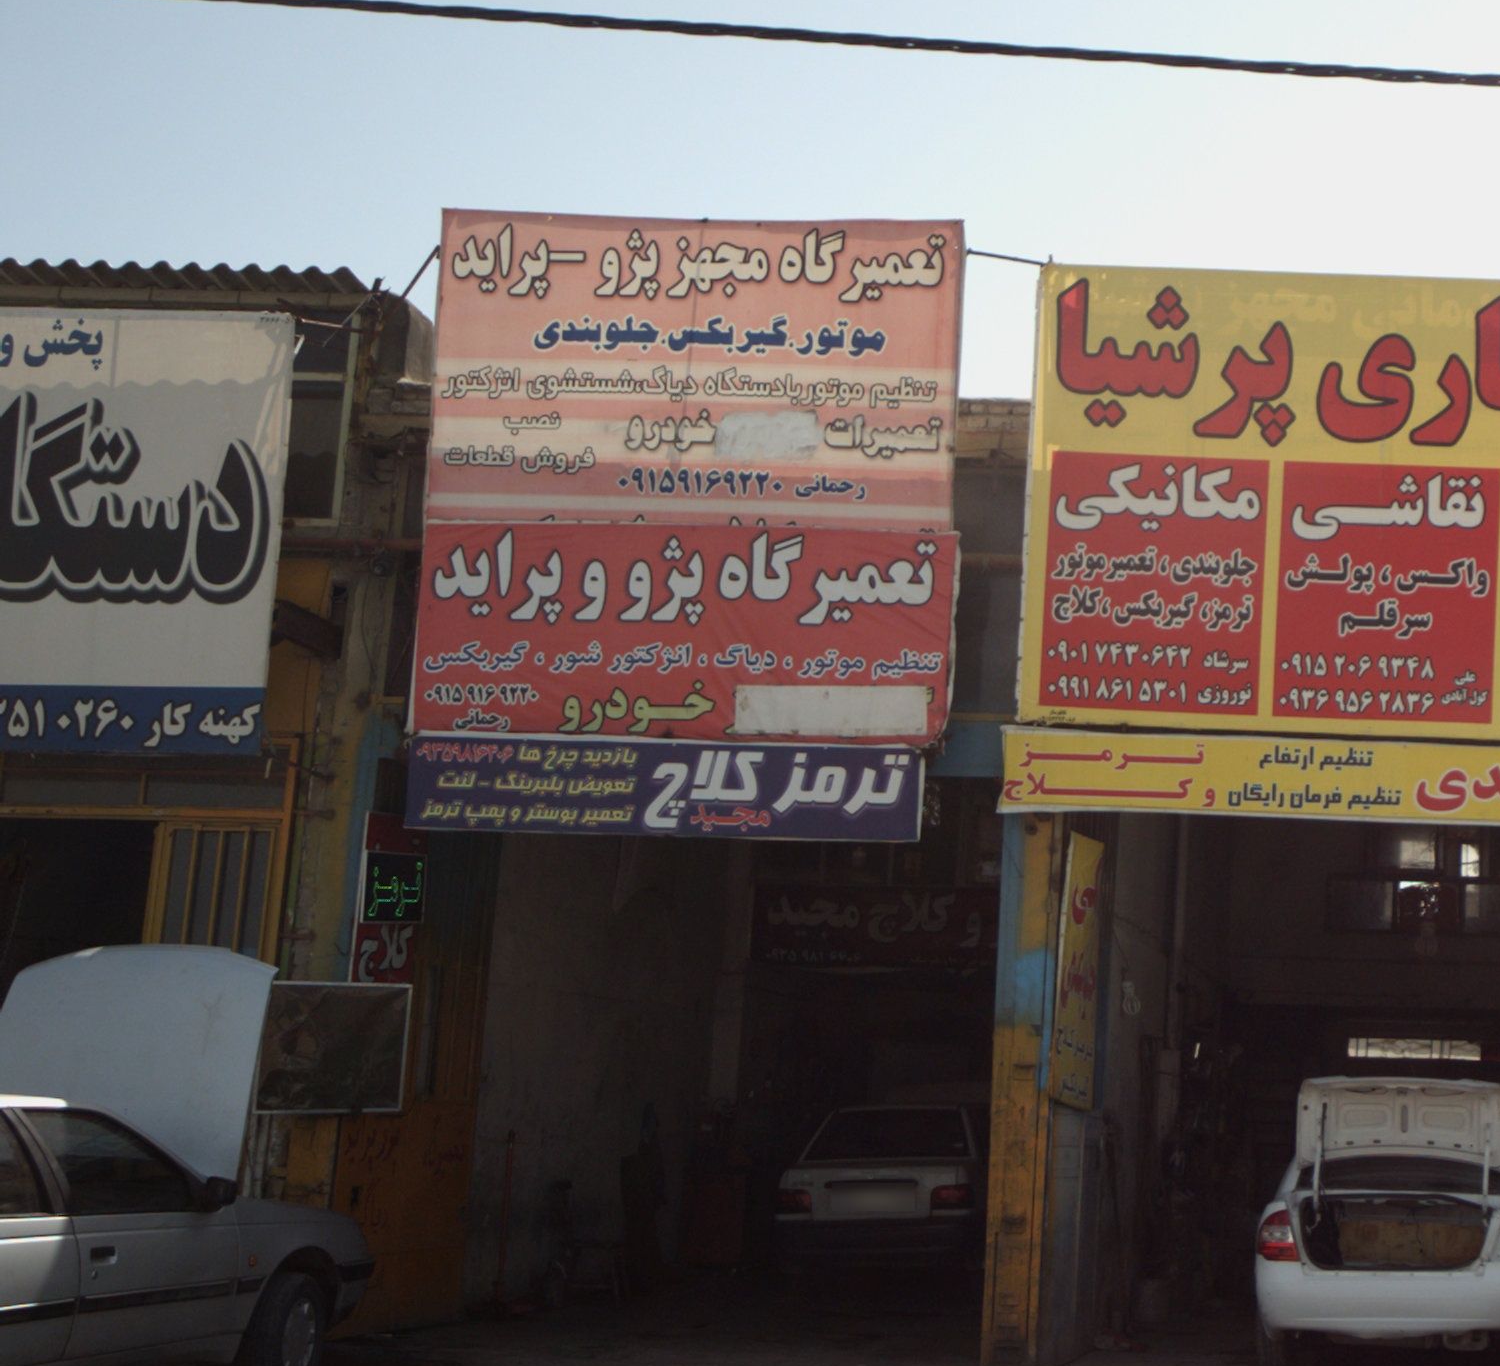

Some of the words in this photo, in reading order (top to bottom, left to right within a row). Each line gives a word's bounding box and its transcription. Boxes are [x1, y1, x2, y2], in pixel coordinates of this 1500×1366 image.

[452, 223, 550, 299] پراید
[594, 228, 661, 300] پژو
[665, 235, 770, 299] مجهز
[23, 318, 104, 370] پخش
[1056, 277, 1296, 447] پرشیا
[440, 366, 520, 399] انژکتور
[527, 368, 635, 399] شستشوی
[869, 375, 939, 409] تنظیم
[502, 411, 562, 435] نصب
[625, 409, 716, 453] خودرو
[824, 414, 943, 459] تعمیرات
[443, 443, 516, 466] قطعات
[521, 445, 596, 474] فروش
[617, 466, 783, 496] ۰۹۱۵۹۱۶۹۲۲۰
[795, 475, 867, 501] رحمانی
[1055, 463, 1262, 532] مکانیکی
[1291, 472, 1485, 541] نقاشی
[433, 528, 564, 624] پراید
[619, 535, 705, 626] پژو
[1171, 548, 1257, 585] جلوبندی
[1285, 553, 1374, 595] پولش
[1396, 556, 1490, 598] واکس
[573, 558, 608, 622] و
[424, 641, 530, 672] گیربکس
[549, 642, 603, 673] شور
[607, 641, 692, 675] انژکتور
[715, 644, 776, 673] دیاگ
[798, 648, 864, 678] موتور
[872, 648, 945, 680] تنظیم
[1047, 639, 1089, 664] ۰۹۰۱
[1280, 651, 1328, 677] ۰۹۱۵
[1333, 654, 1373, 679] ۲۰۶
[1378, 654, 1436, 681] ۹۳۴۸
[425, 682, 463, 706] ۰۹۱۵
[466, 683, 497, 705] ۹۱۶
[500, 682, 540, 705] ۹۲۲۰
[1047, 675, 1090, 699] ۰۹۹۱
[1095, 677, 1133, 701] ۸۶۱
[1138, 677, 1188, 703] ۵۳۰۱
[1197, 682, 1252, 706] نوروزی
[1279, 687, 1330, 711] ۰۹۳۶
[1334, 688, 1374, 713] ۹۵۶
[1379, 690, 1436, 715] ۲۸۳۶
[453, 707, 510, 731] رحمانی
[556, 678, 716, 734] خودرو
[143, 701, 193, 747] کار
[198, 702, 262, 746] کهنه
[518, 744, 542, 763] ها
[543, 744, 579, 770] چرخ
[581, 747, 638, 770] بازدید
[1018, 742, 1206, 771] ترمز
[1258, 744, 1315, 770] ارتفاع
[1319, 746, 1375, 771] تنظیم
[436, 771, 477, 789] لنت
[495, 771, 565, 797] بلبرینگ
[567, 776, 638, 797] تعویض
[643, 750, 766, 831] کلاچ
[771, 751, 912, 816] ترمز
[1227, 782, 1285, 808] رایگان
[420, 797, 463, 820] ترمز
[1202, 787, 1217, 808] و
[1289, 784, 1343, 810] فرمان
[1347, 785, 1403, 811] تنظیم
[581, 804, 635, 826] تعمیر
[690, 803, 773, 832] مجید
